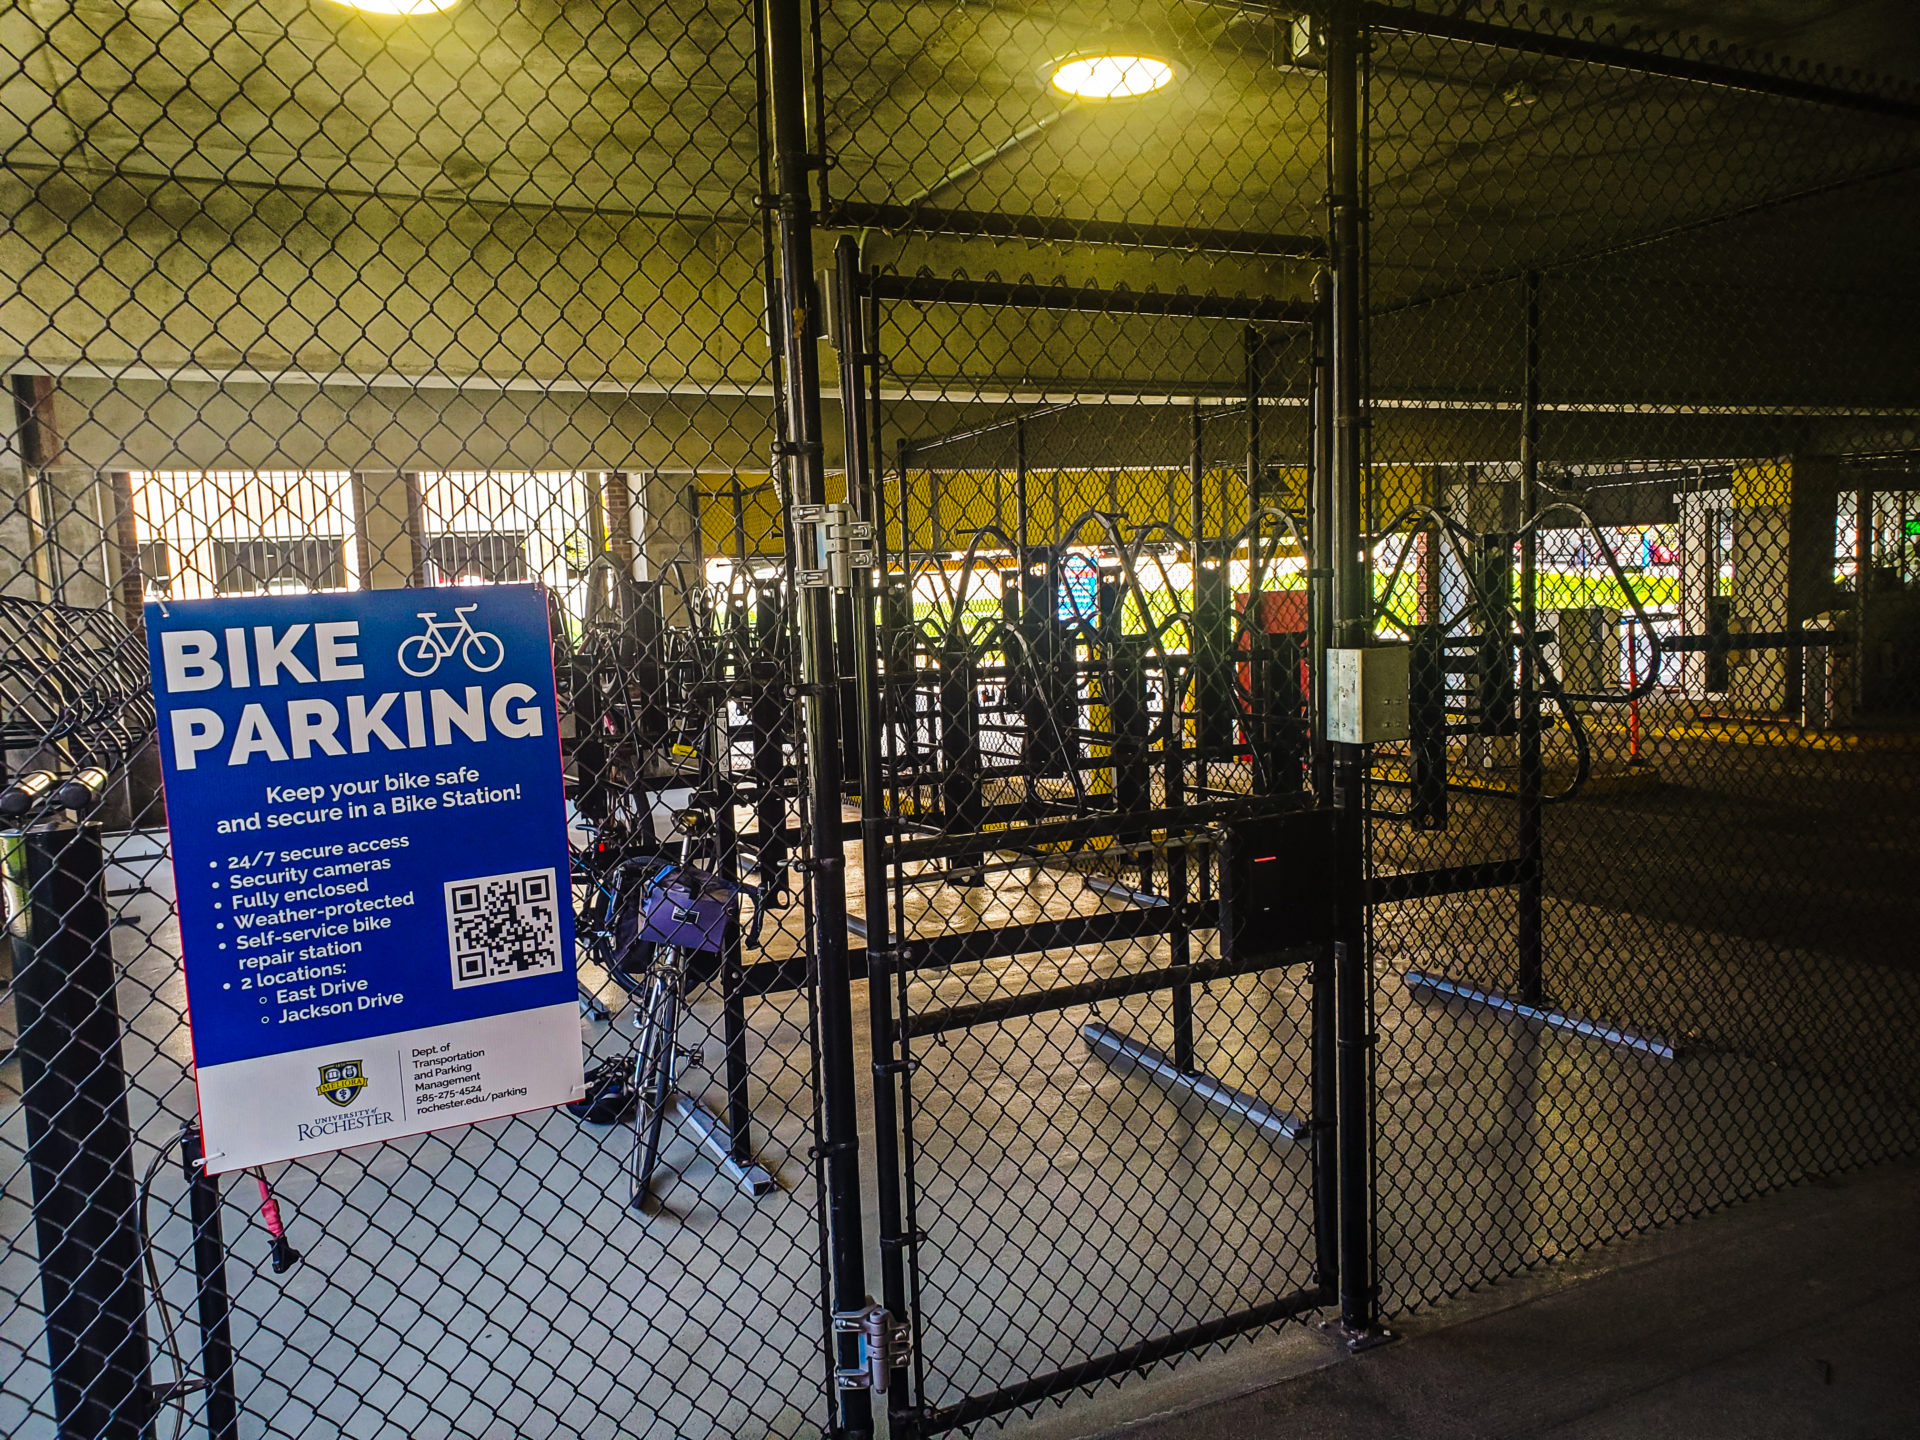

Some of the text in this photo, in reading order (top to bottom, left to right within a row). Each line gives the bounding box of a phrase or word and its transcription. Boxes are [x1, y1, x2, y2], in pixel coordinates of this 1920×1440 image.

[161, 620, 364, 693] BIKE
[169, 682, 545, 771] PARKING
[266, 767, 480, 805] Keep your bike safe
[216, 783, 522, 834] and secure in a Bike Station!
[228, 835, 410, 870] 24/7 secure access
[230, 857, 391, 890] Security cameras
[232, 878, 369, 911] Fully enclosed
[234, 891, 415, 931] Weather-protected
[236, 914, 392, 951] Self-service bike
[238, 938, 362, 972] repair station
[241, 962, 347, 990] 2 locations:
[276, 977, 368, 1005] East Drive
[278, 991, 404, 1024] Jackson Drive
[412, 1042, 451, 1058] Dept. of
[413, 1049, 485, 1069] Transportation
[322, 1079, 362, 1092] MELIORA
[414, 1063, 472, 1080] and Parking
[415, 1072, 481, 1092] Management
[416, 1084, 482, 1104] 585-275-4524
[417, 1087, 527, 1115] rochester.edu/parking
[297, 1111, 394, 1141] ROCHESTER
[315, 1109, 370, 1124] UNIVERSITY
